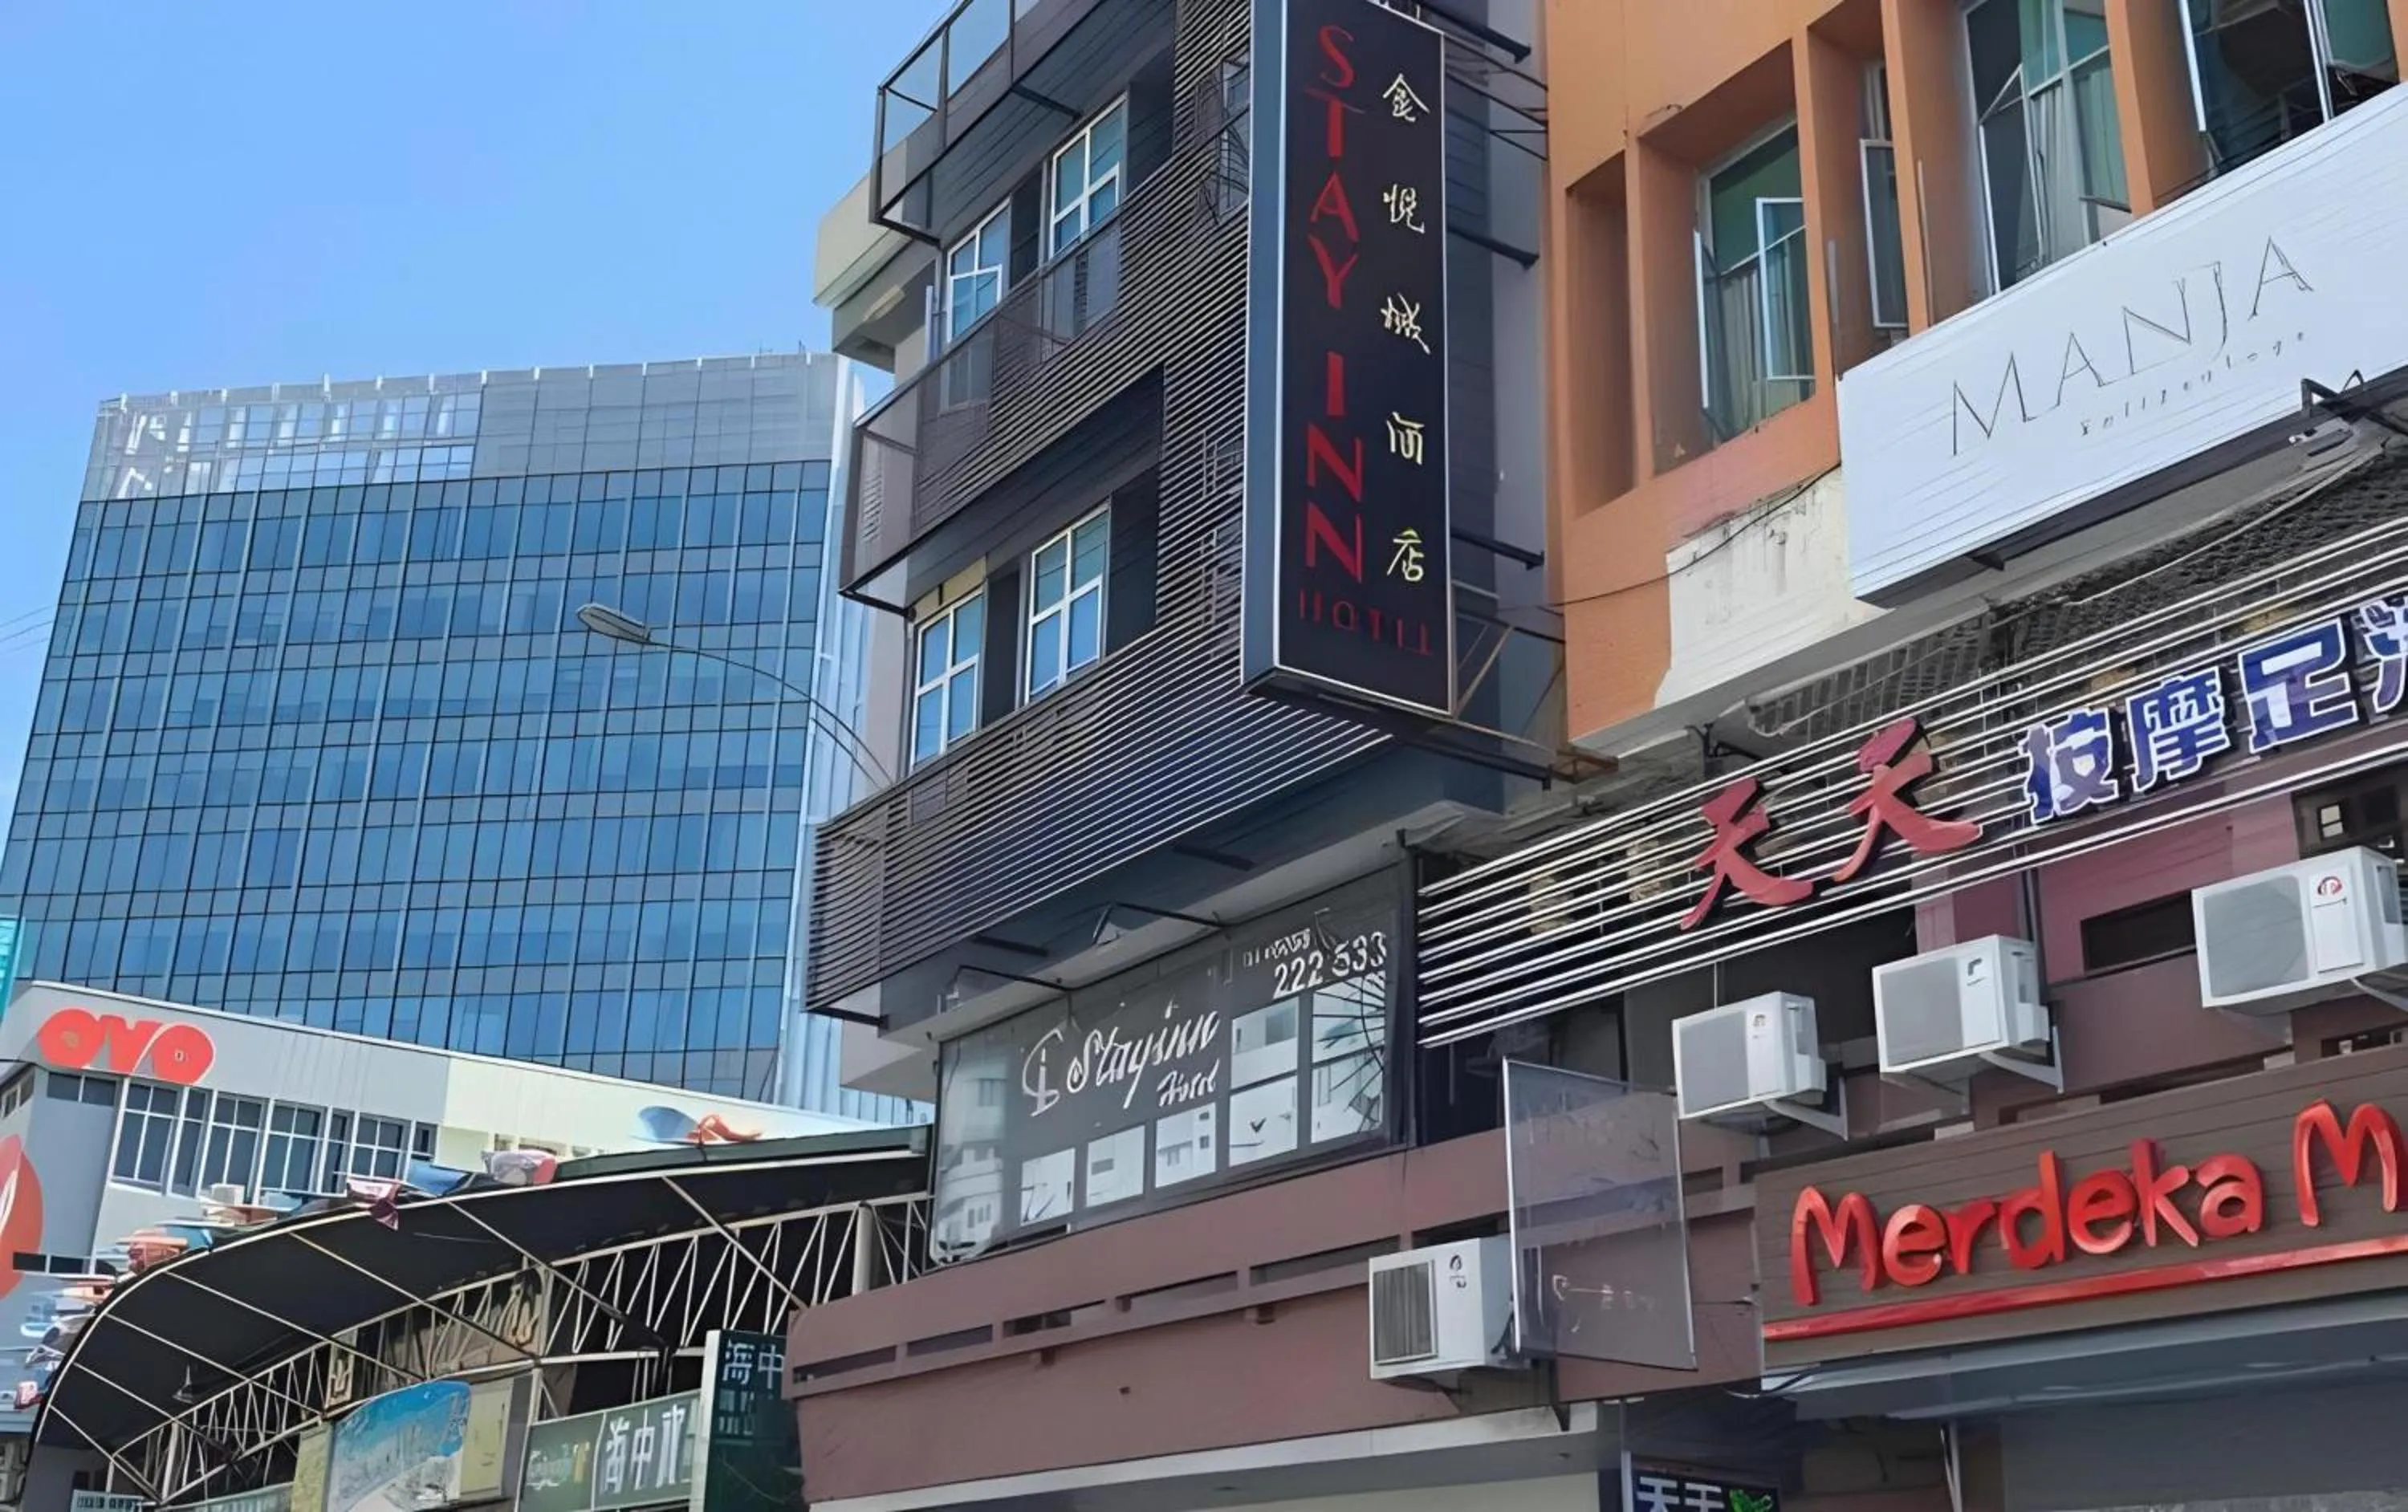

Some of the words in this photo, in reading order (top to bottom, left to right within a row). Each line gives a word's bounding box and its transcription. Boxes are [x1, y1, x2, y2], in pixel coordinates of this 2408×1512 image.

[1306, 24, 1363, 310] STAY
[1950, 236, 2315, 457] MANJA
[1305, 351, 1363, 583] INN
[1272, 949, 1324, 999] 222
[1790, 1136, 2265, 1307] Merdeka
